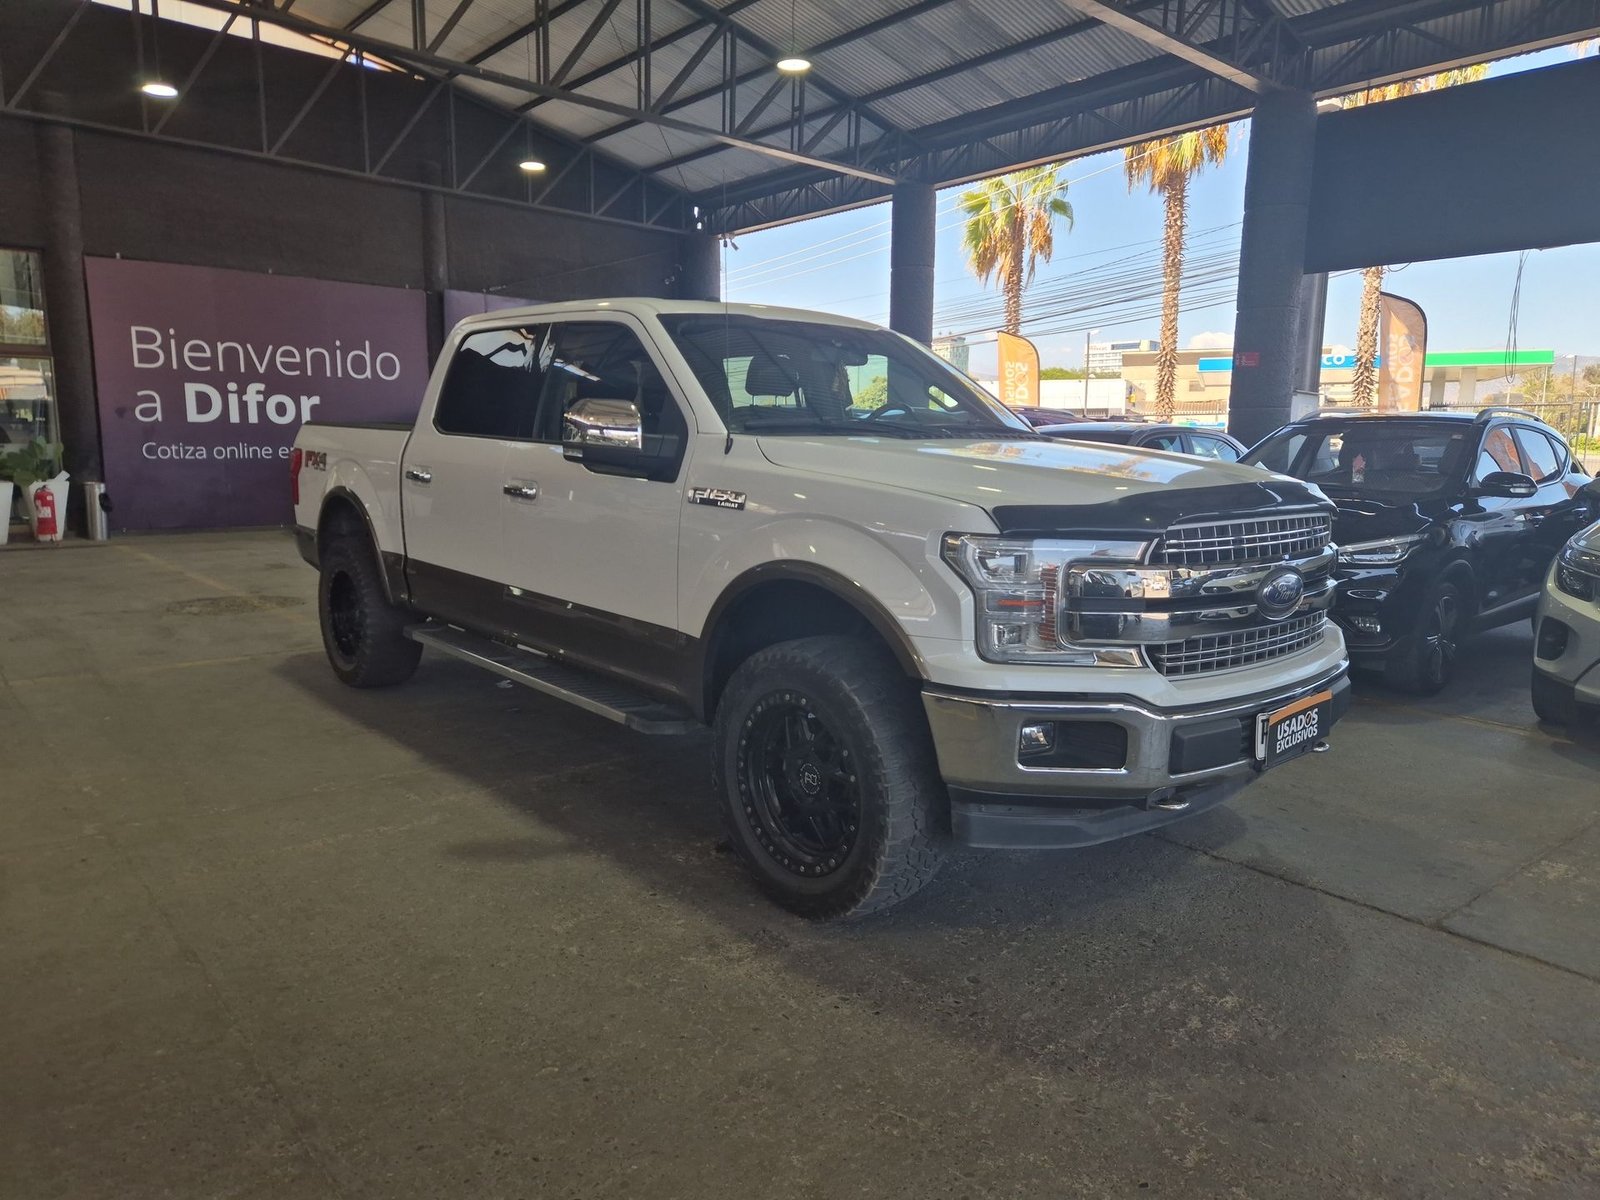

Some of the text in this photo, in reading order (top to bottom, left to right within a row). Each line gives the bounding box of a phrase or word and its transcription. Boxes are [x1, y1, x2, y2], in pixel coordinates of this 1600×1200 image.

[130, 325, 400, 381] Bienvenido
[134, 382, 320, 424] a Difor
[142, 442, 293, 459] Cotiza online e
[1276, 724, 1318, 753] EXCLUSIVOS
[1277, 708, 1318, 740] USADOS
